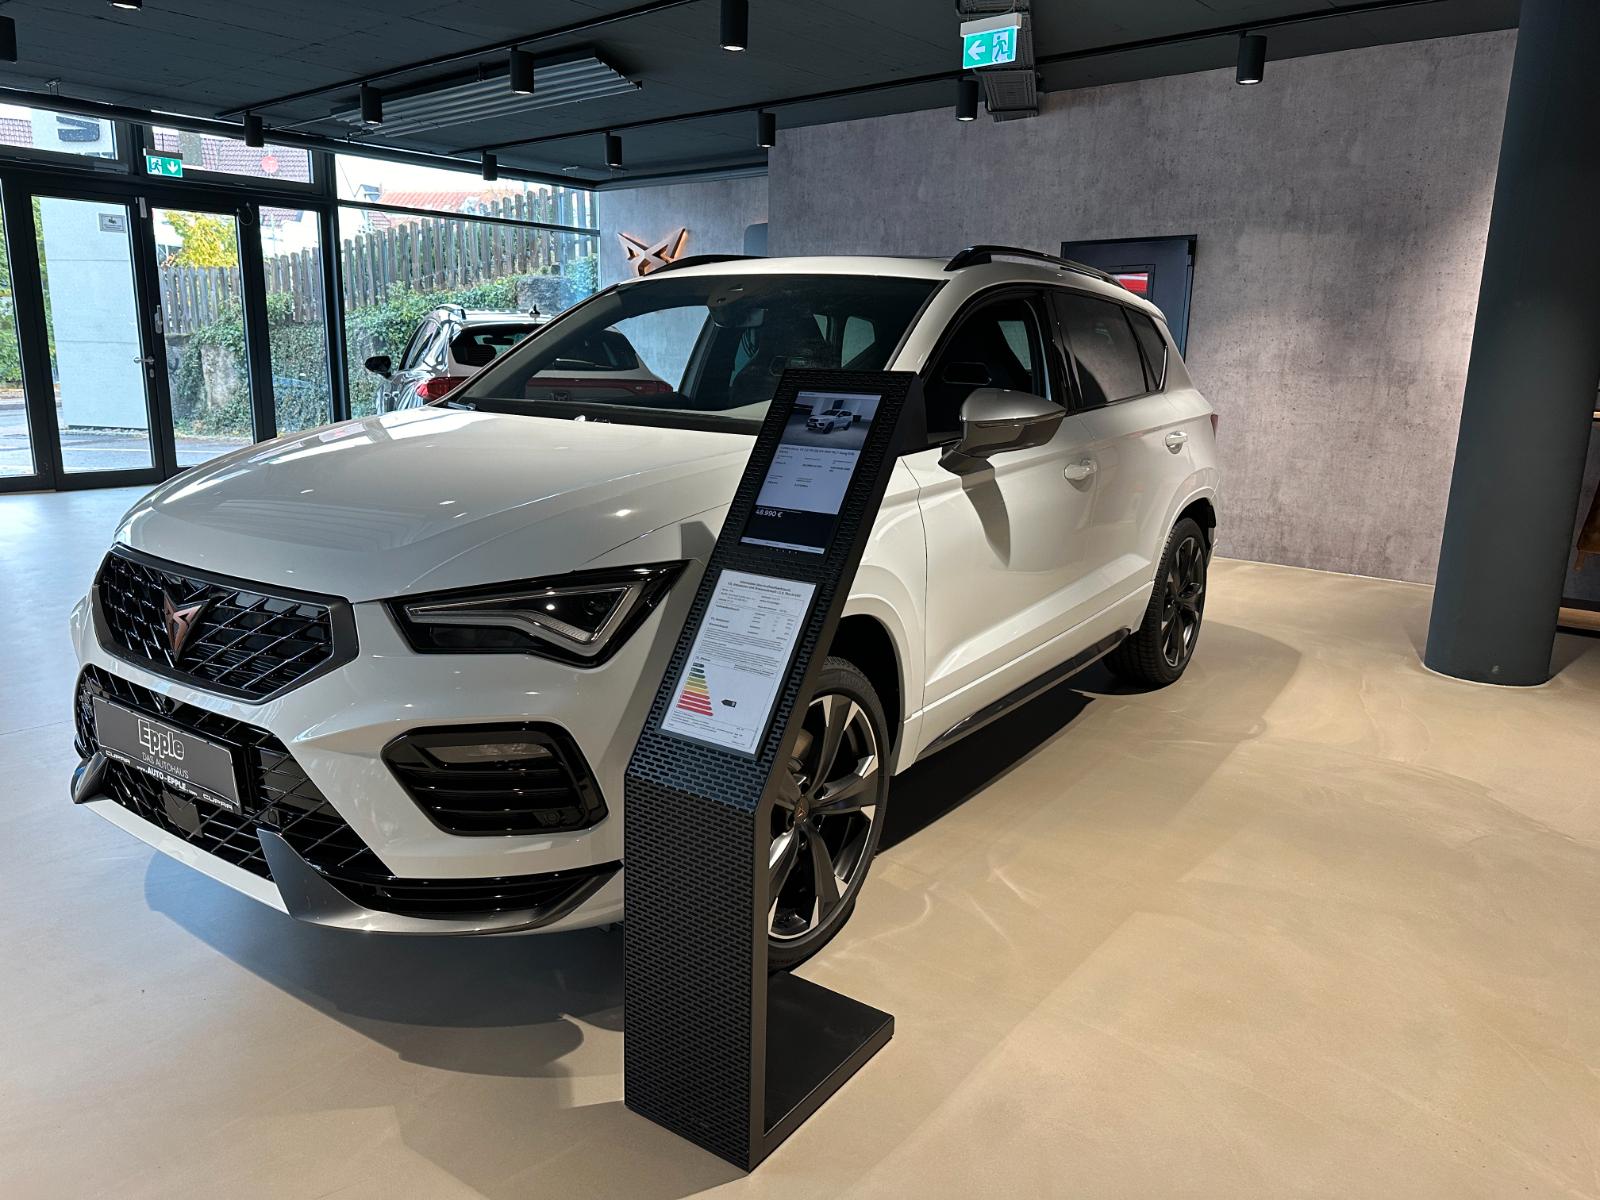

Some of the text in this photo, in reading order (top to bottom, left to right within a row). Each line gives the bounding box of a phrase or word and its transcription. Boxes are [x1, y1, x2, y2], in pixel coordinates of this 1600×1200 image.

[137, 718, 185, 761] Epple
[142, 752, 190, 780] DAS AUTOHAUS
[203, 793, 234, 811] CUPRA
